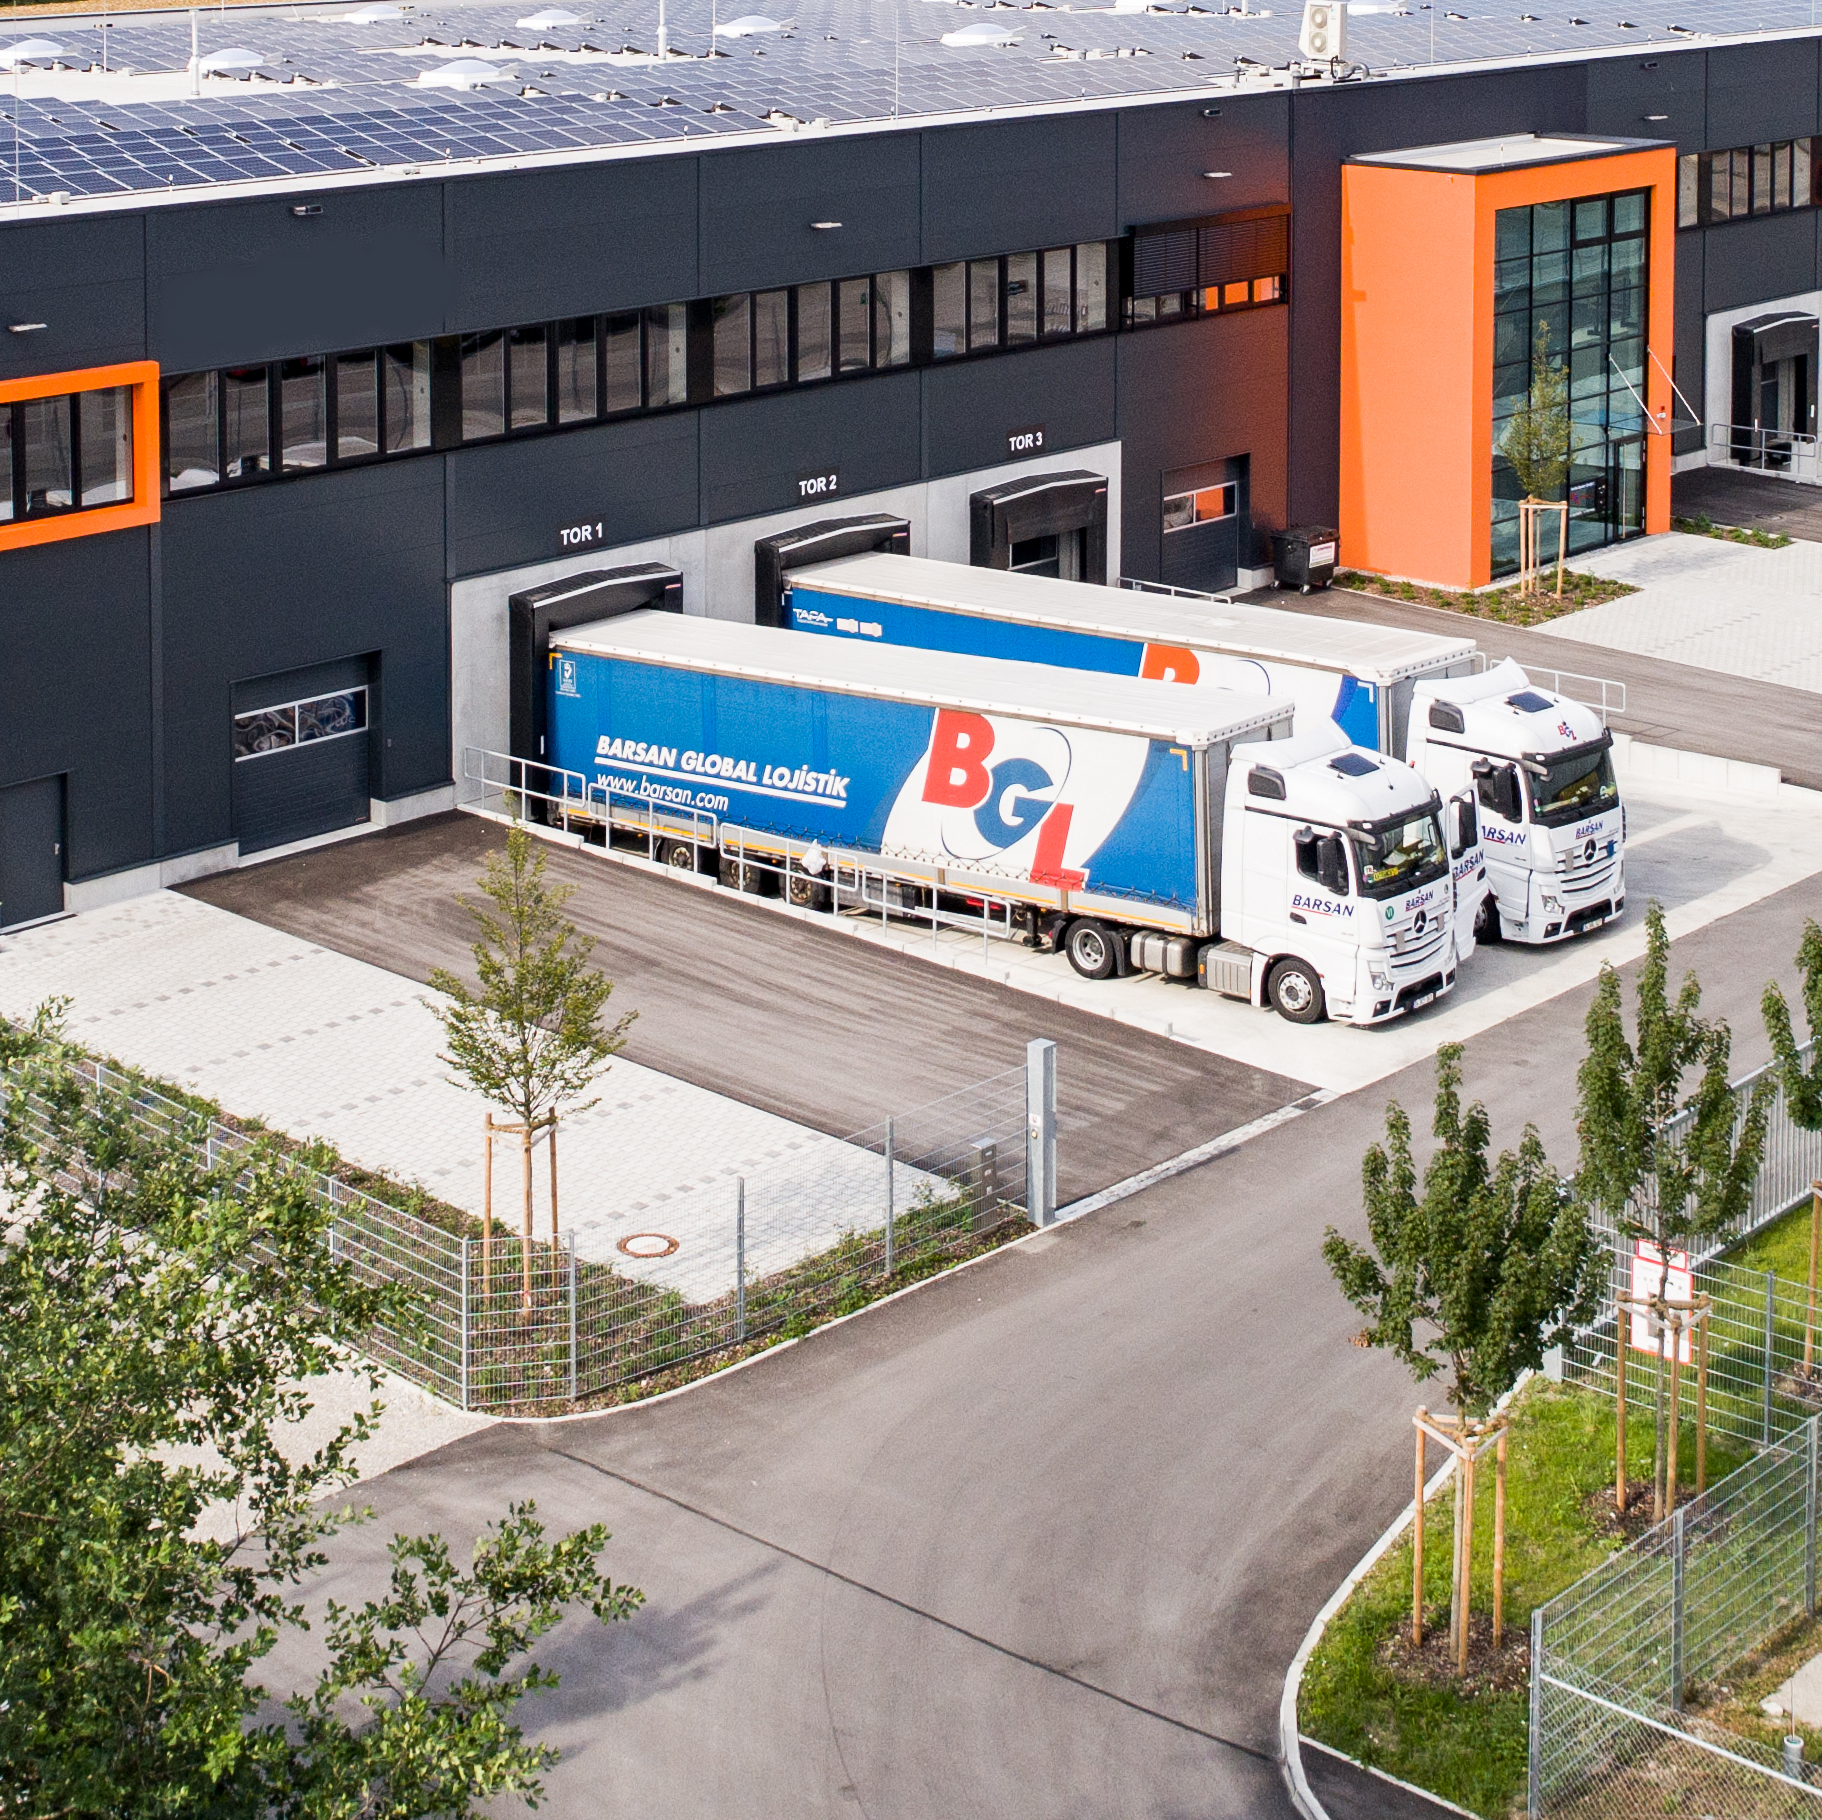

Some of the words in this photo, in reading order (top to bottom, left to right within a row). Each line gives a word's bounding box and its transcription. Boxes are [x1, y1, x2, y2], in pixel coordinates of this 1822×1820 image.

[1009, 433, 1034, 451] TOR
[1035, 431, 1043, 446] 3
[799, 476, 827, 496] TOR
[829, 474, 837, 490] 2
[560, 524, 593, 546] TOR
[595, 522, 603, 539] 1
[596, 734, 678, 768] BARSAN
[680, 750, 758, 782] GLOBAL
[596, 772, 730, 812] www.barsan.com
[921, 707, 1090, 893] BGL
[1576, 820, 1604, 838] BARSAN
[1292, 893, 1355, 918] BARSAN
[1405, 889, 1434, 911] BARSAN
